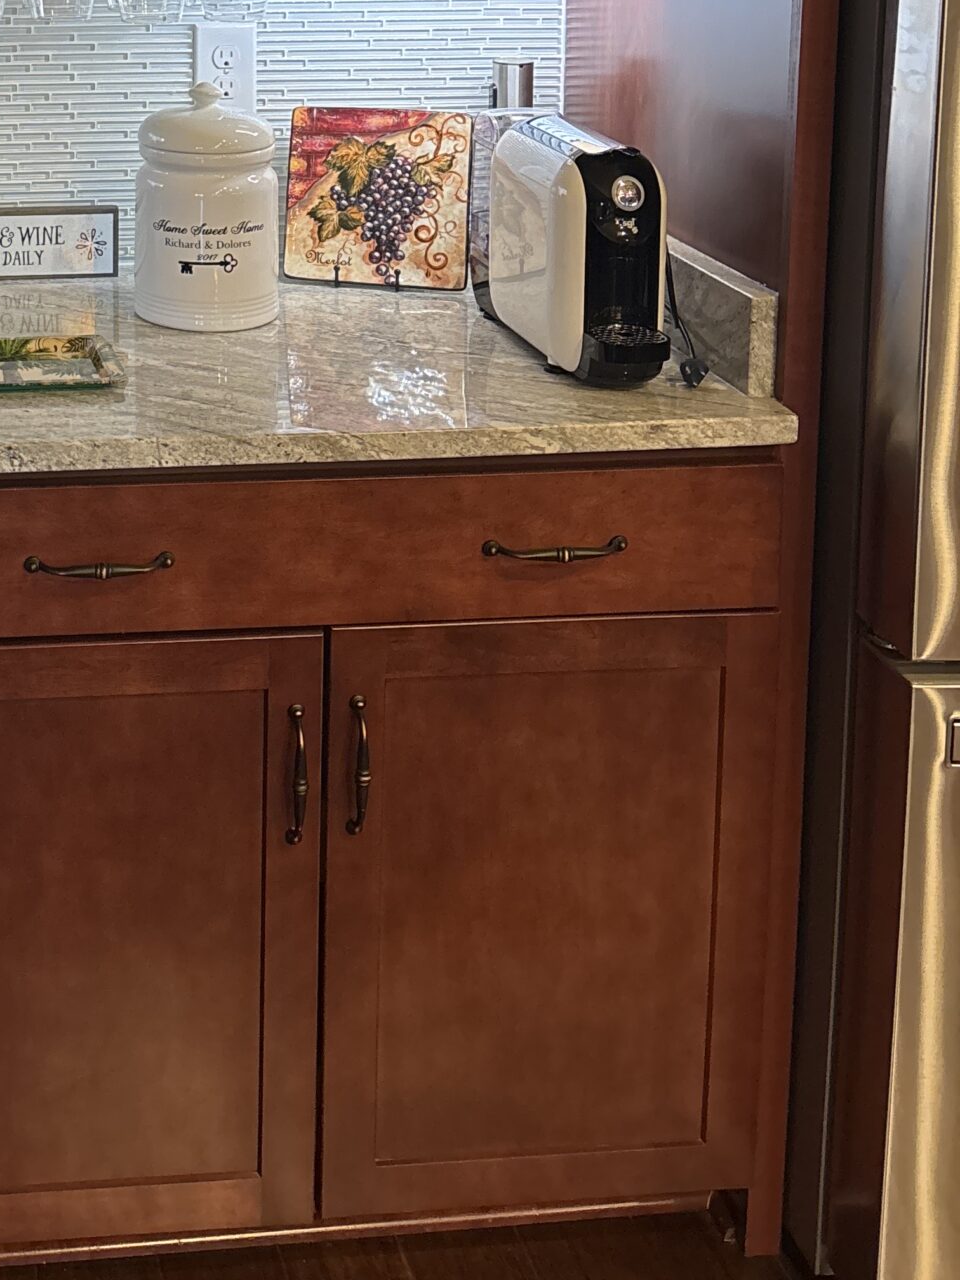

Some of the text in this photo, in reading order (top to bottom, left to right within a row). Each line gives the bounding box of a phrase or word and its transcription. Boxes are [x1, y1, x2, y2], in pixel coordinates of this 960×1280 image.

[152, 219, 265, 236] Home Sweet Home
[0, 226, 15, 248] &
[17, 225, 66, 246] WINE
[164, 237, 252, 250] Richard & Dolores
[2, 250, 45, 266] DAILY
[196, 253, 219, 261] 2017
[305, 247, 352, 267] Merlot
